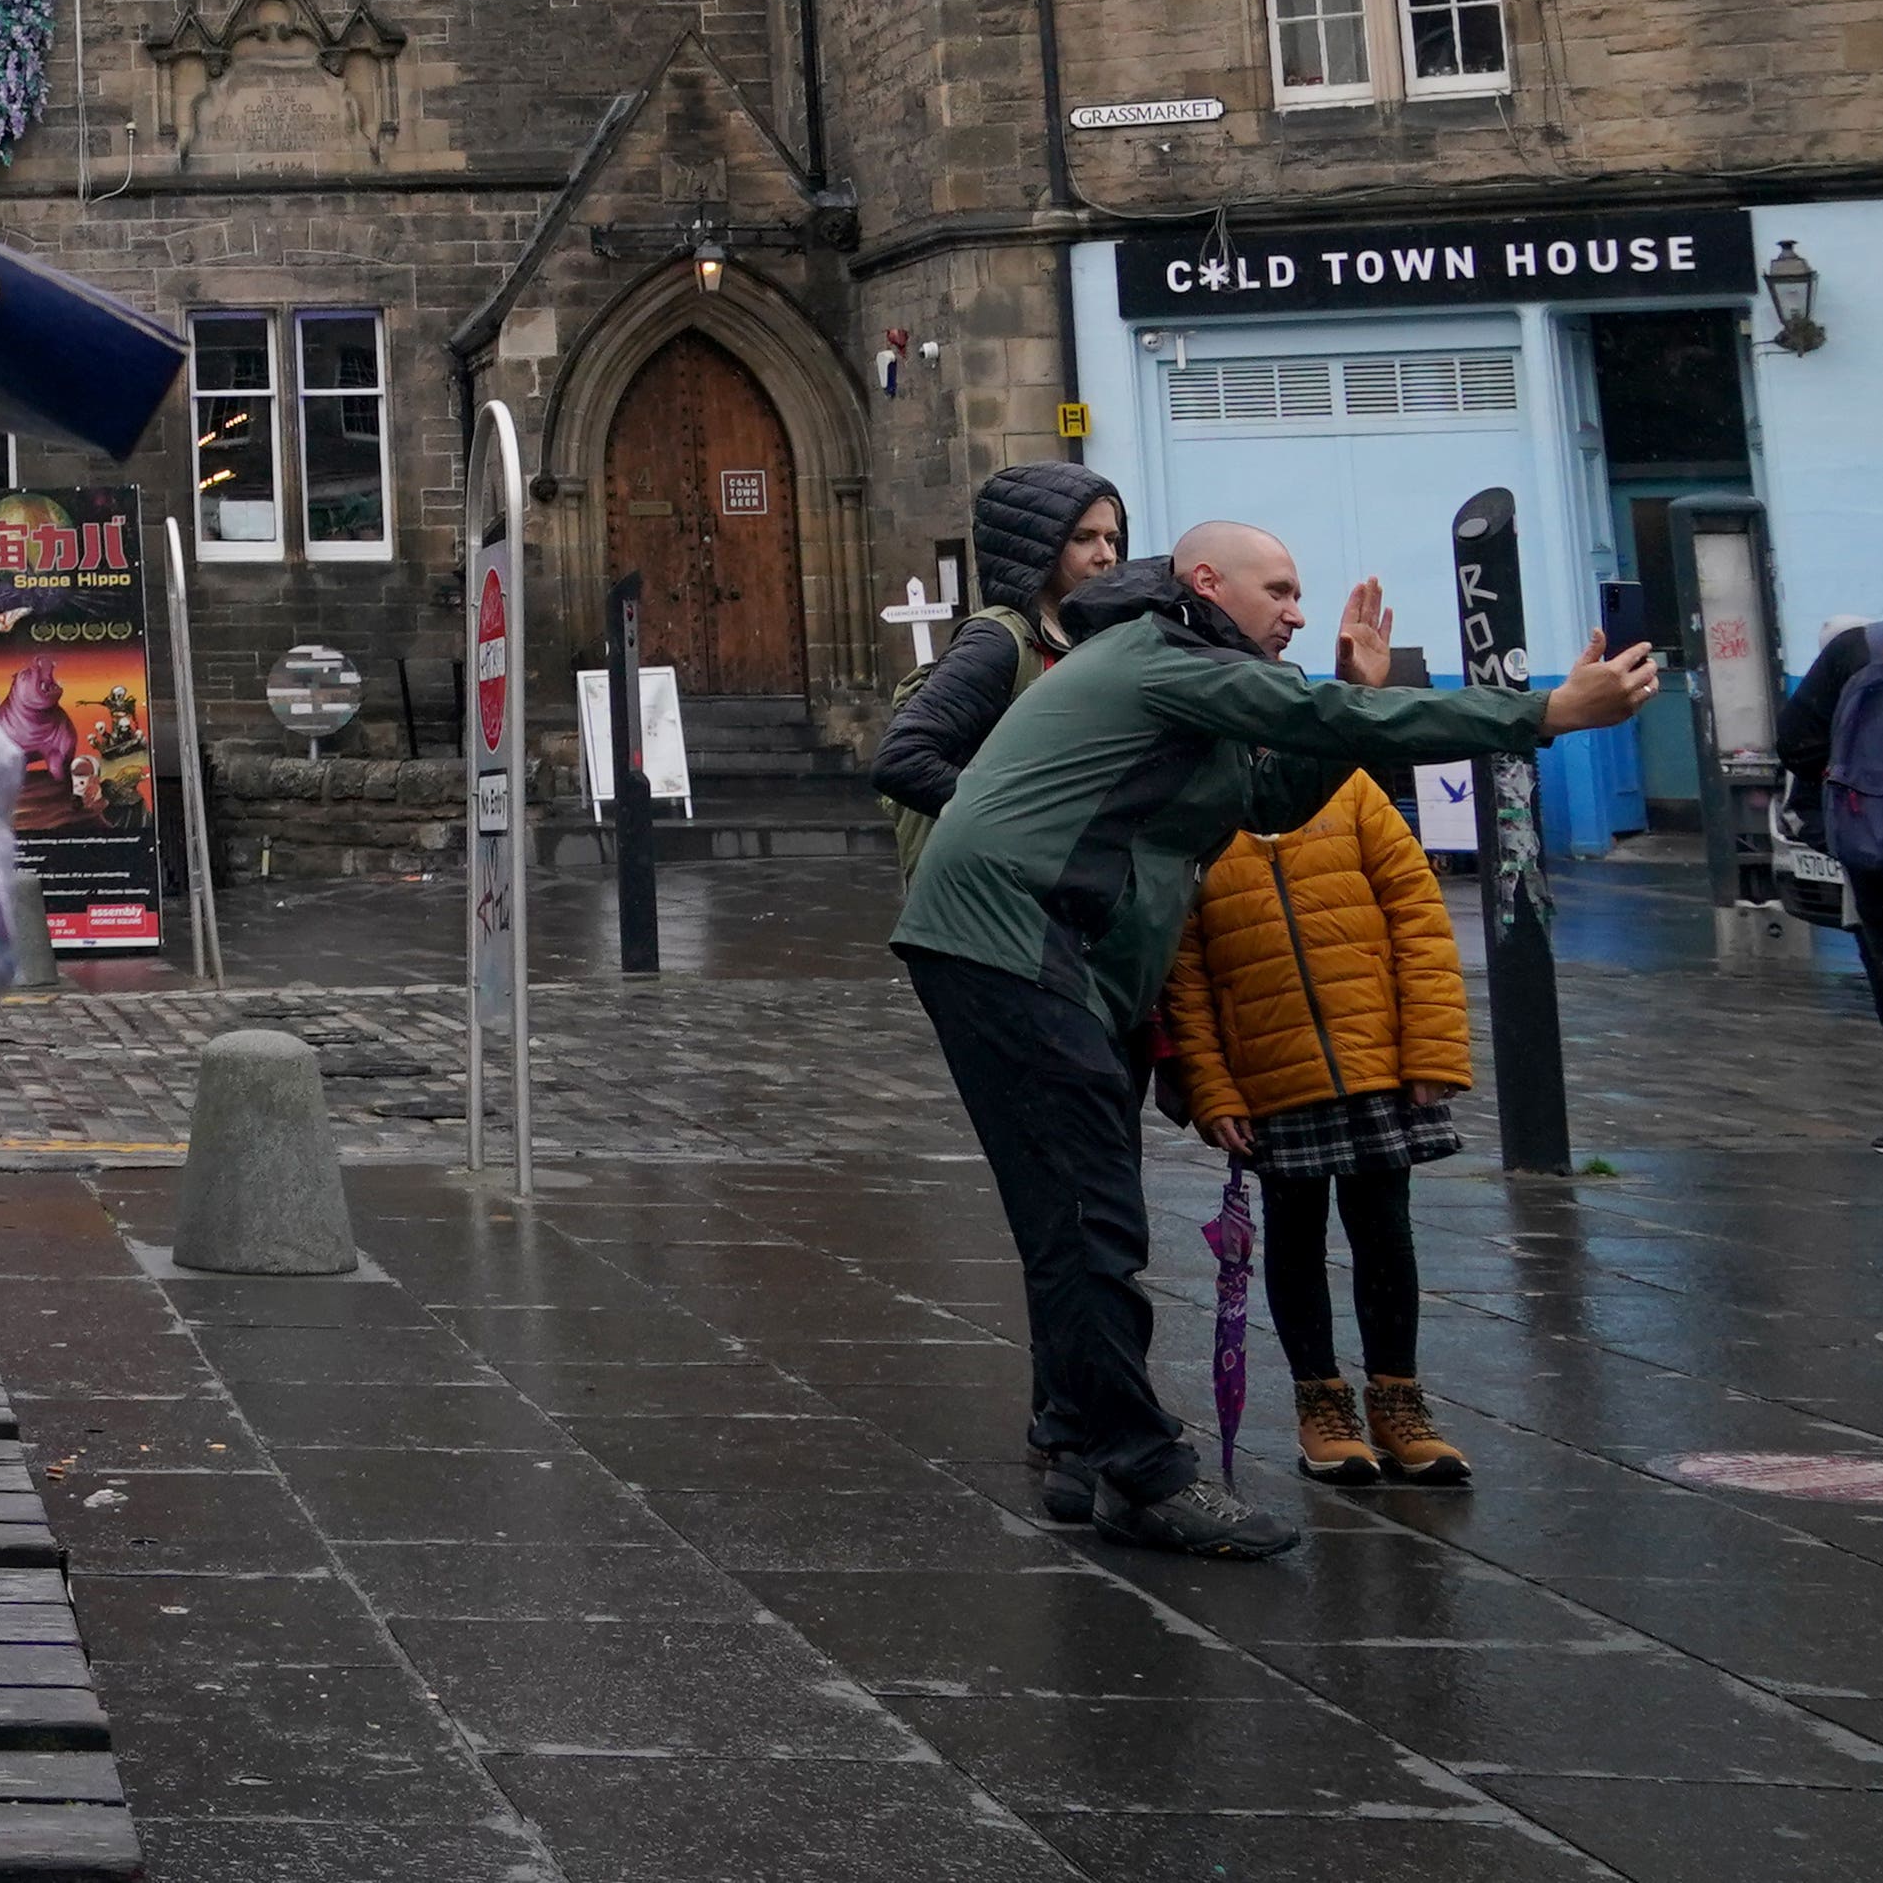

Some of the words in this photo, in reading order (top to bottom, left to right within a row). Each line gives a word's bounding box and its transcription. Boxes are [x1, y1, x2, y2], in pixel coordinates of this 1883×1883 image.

[1078, 101, 1214, 126] GRASSMARKET
[1321, 245, 1476, 285] TOWN
[1505, 235, 1697, 277] HOUSE
[729, 487, 760, 497] TOWN
[729, 497, 760, 508] BEER
[13, 574, 71, 589] Space
[76, 572, 132, 587] Hippo
[490, 781, 508, 814] Entry
[90, 905, 144, 918] assembly
